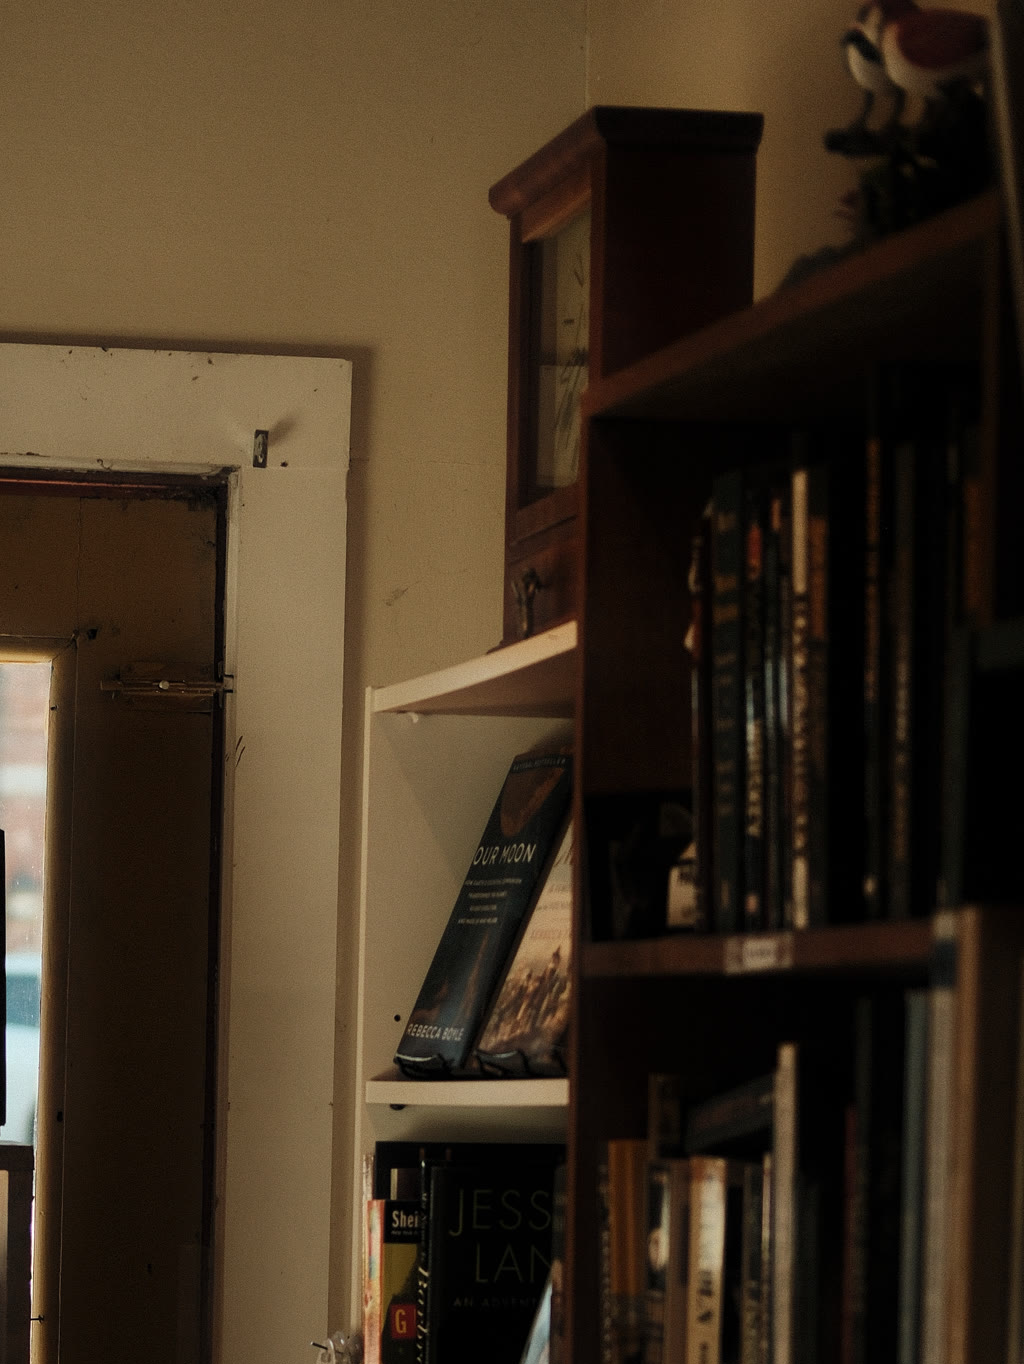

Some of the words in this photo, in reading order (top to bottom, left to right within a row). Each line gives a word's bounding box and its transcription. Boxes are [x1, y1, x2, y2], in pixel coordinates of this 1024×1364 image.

[473, 846, 500, 866] OUR
[499, 842, 536, 864] MOON
[407, 1023, 442, 1039] REBECCA
